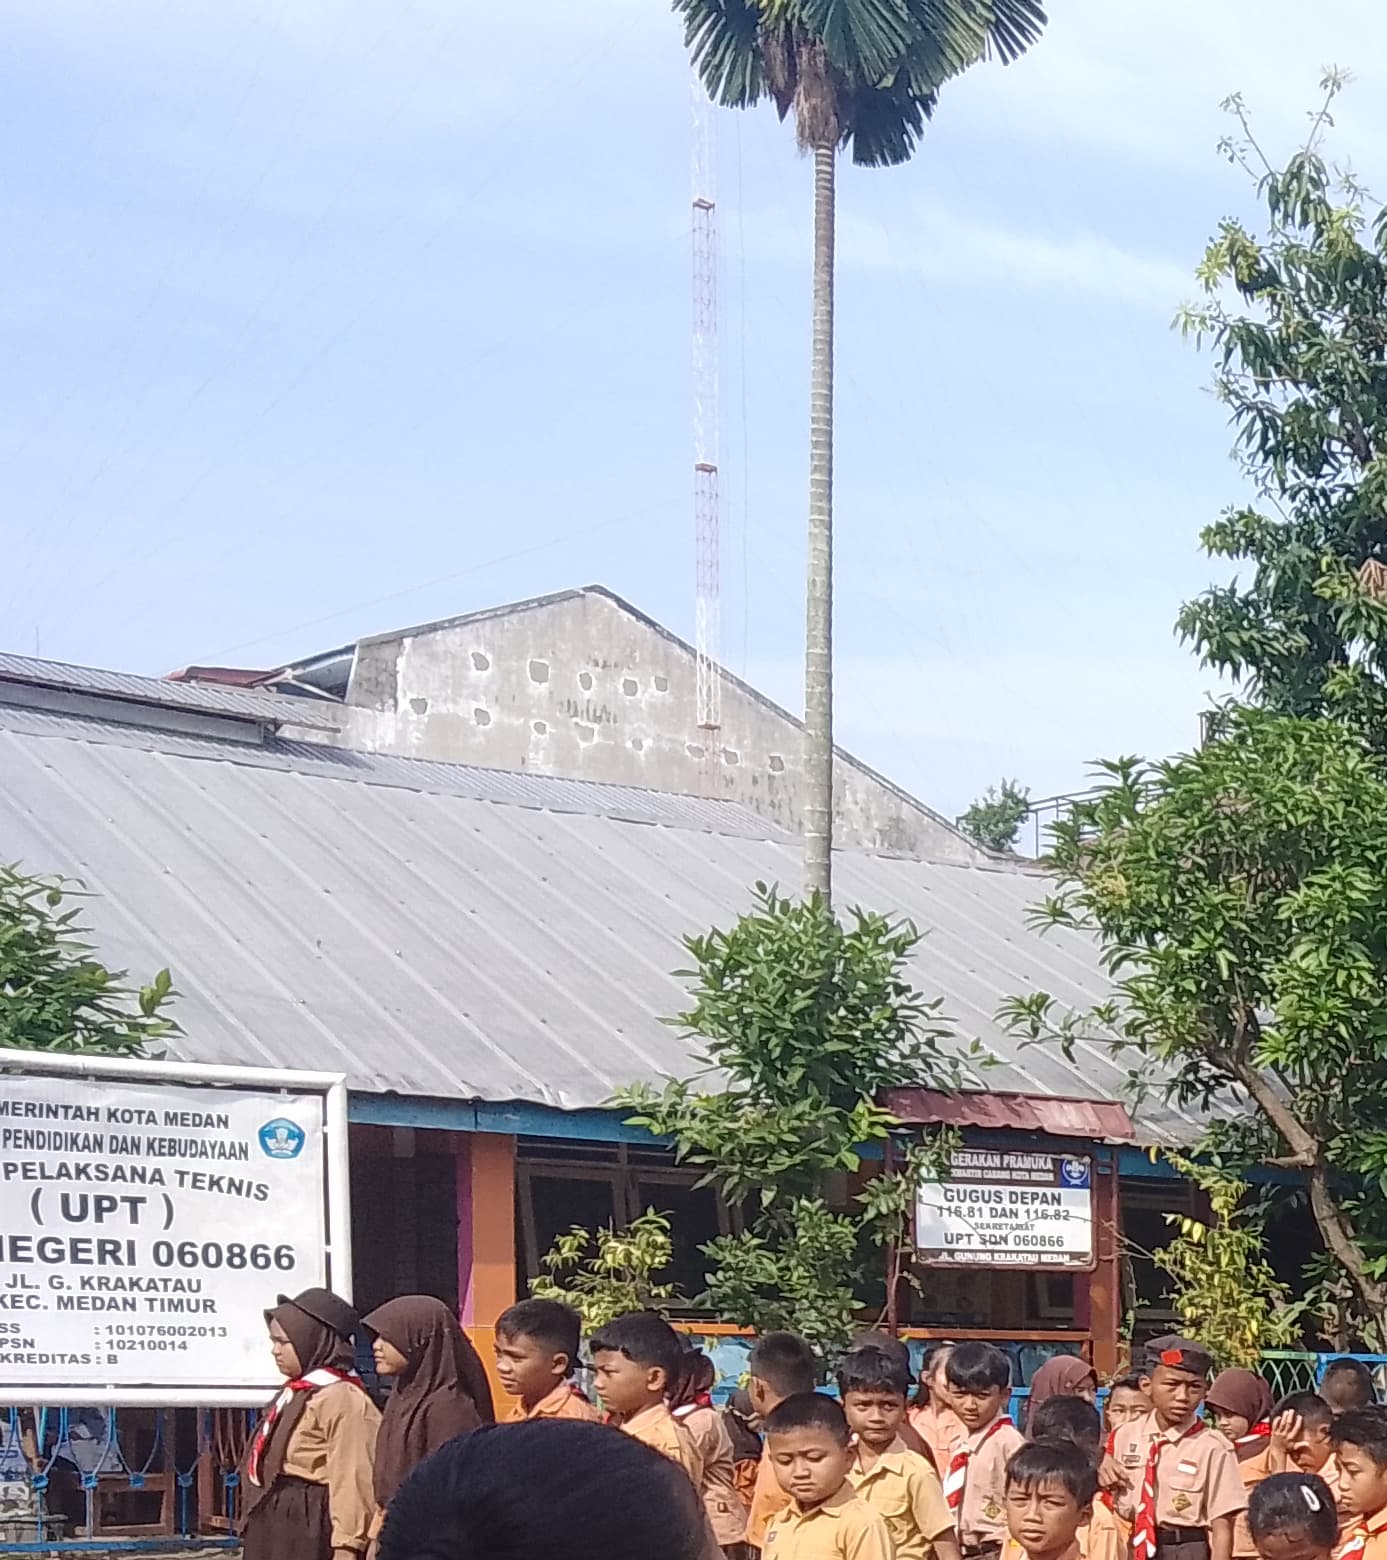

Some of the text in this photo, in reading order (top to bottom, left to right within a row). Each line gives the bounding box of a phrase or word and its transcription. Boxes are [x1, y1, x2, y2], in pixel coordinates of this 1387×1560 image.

[106, 1107, 158, 1126] KOTA
[163, 1110, 230, 1129] MEDAN
[2, 1128, 249, 1161] PENDIDIKAN DAN KEBUDAYAAN
[950, 1152, 1000, 1168] GERAKAN
[2, 1161, 270, 1201] PELAKSANA TEKNIS
[943, 1188, 1062, 1207] GUGUS DEPAN
[60, 1192, 147, 1225] UPT
[937, 1205, 1071, 1222] 116.81 DAN 116.82
[943, 1232, 975, 1246] UPT
[1013, 1235, 1065, 1248] 060866
[0, 1234, 296, 1271] EGERI 060866
[4, 1273, 202, 1294] JL. G. KRAKATAU
[57, 1295, 137, 1313] MEDAN
[144, 1297, 218, 1314] TIMUR
[105, 1325, 228, 1338] 101076002013
[0, 1338, 35, 1350] PSN
[105, 1340, 188, 1352] 10210014
[0, 1353, 92, 1365] KREDITAS
[106, 1354, 119, 1366] B
